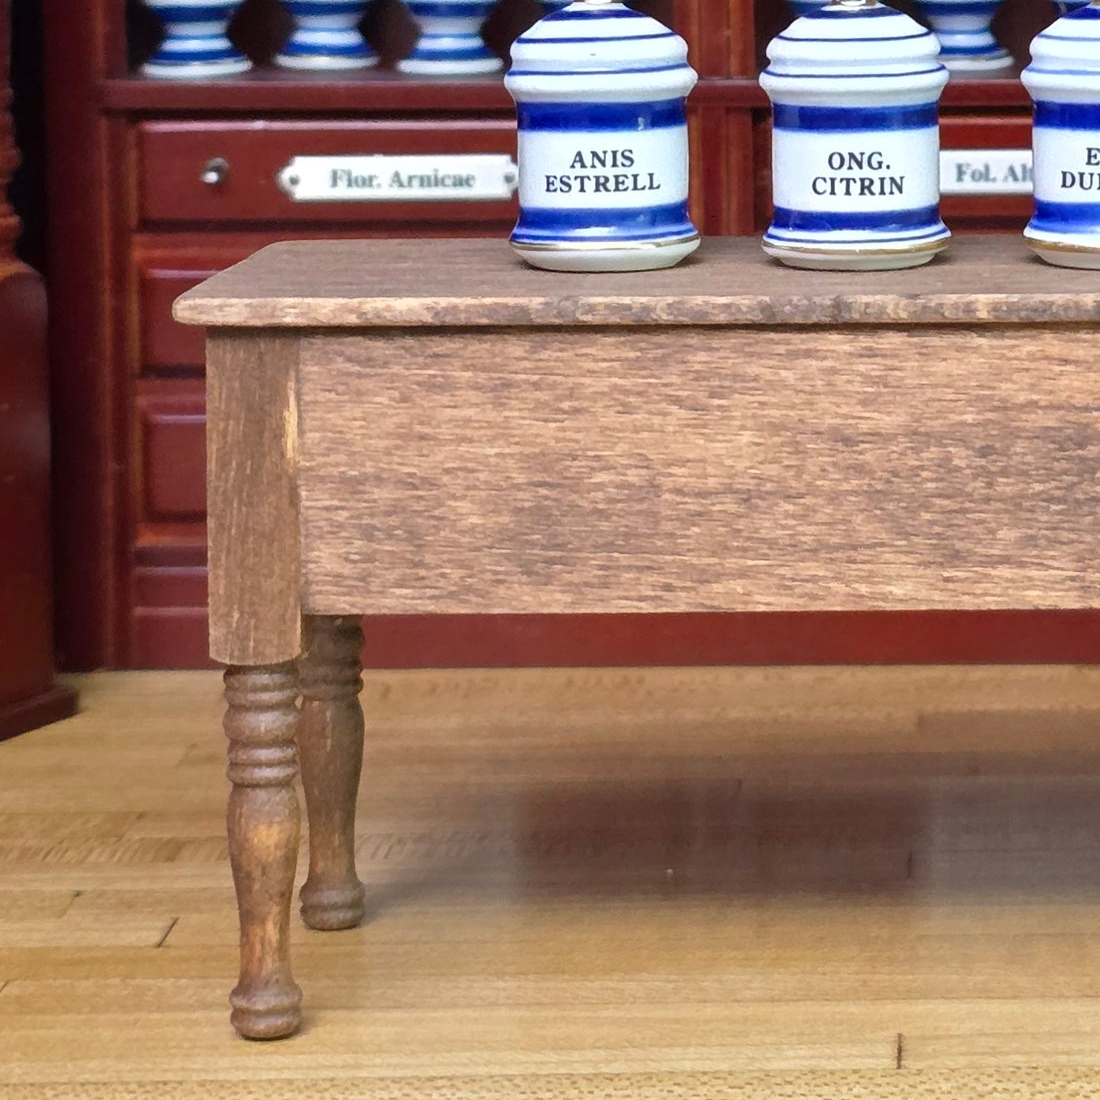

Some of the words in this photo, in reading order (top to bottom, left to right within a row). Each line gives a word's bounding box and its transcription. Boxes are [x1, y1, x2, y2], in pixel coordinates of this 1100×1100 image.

[570, 149, 635, 169] ANIS
[828, 151, 891, 171] ONG.
[330, 168, 381, 190] Flor.
[389, 168, 476, 189] Arnicae
[954, 162, 996, 183] Fol.
[545, 173, 661, 194] ESTRELL
[811, 175, 905, 196] CITRIN
